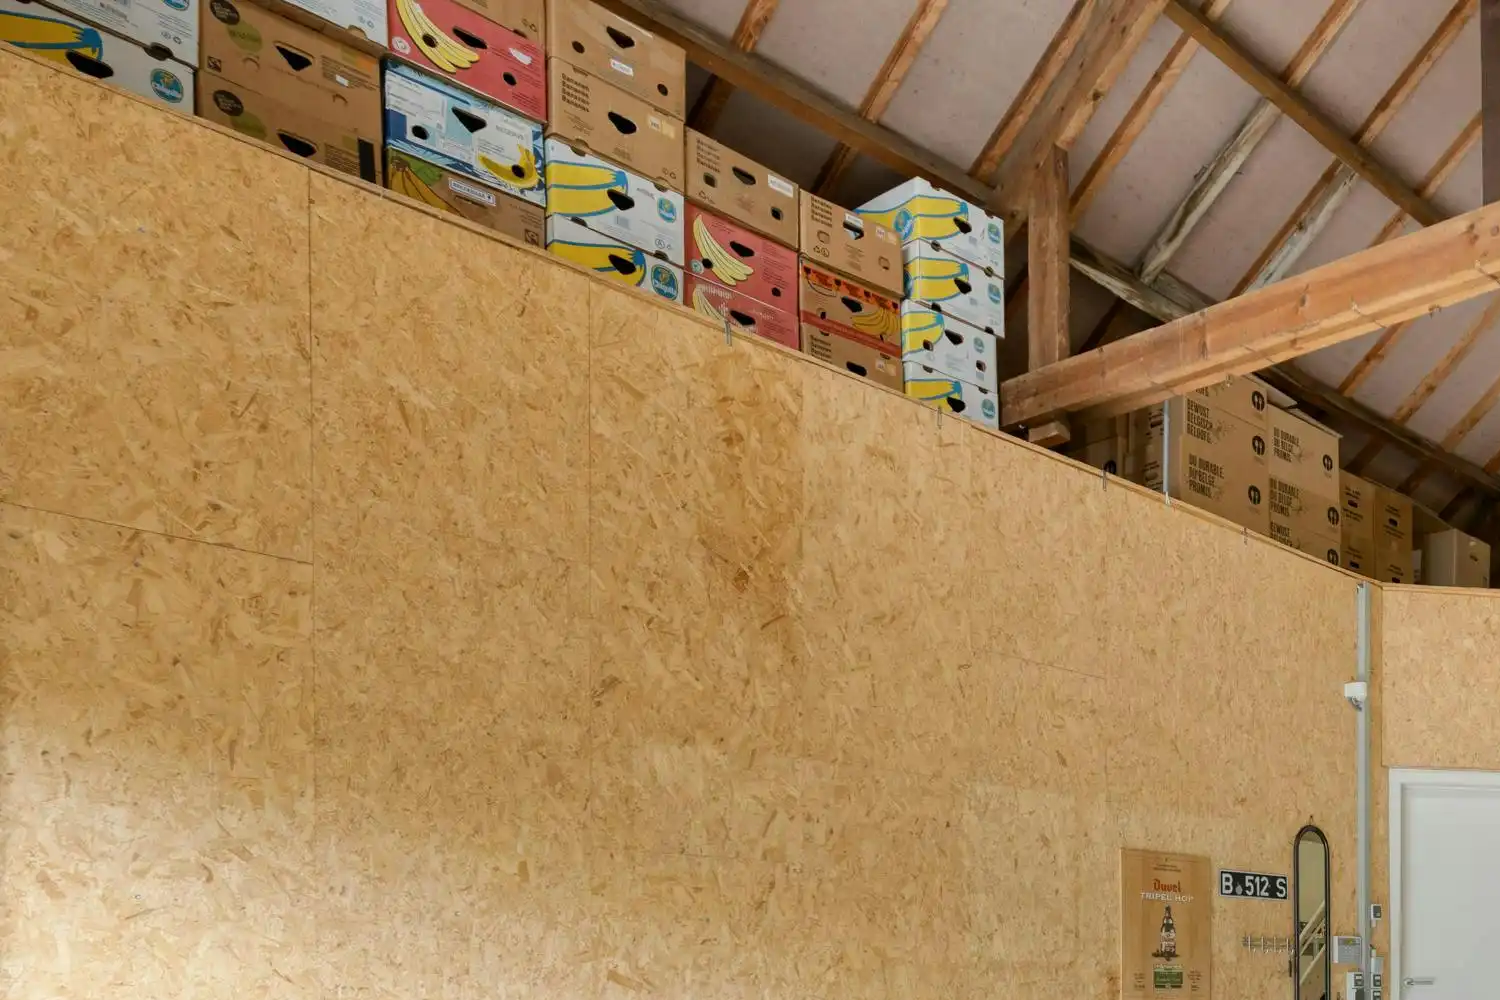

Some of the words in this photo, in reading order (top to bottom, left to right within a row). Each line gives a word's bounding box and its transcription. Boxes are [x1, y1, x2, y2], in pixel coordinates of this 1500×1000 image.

[1153, 878, 1182, 892] Duvel
[1222, 873, 1233, 894] B
[1245, 875, 1269, 896] 512
[1276, 878, 1286, 897] S
[1141, 892, 1173, 901] TRIPEL
